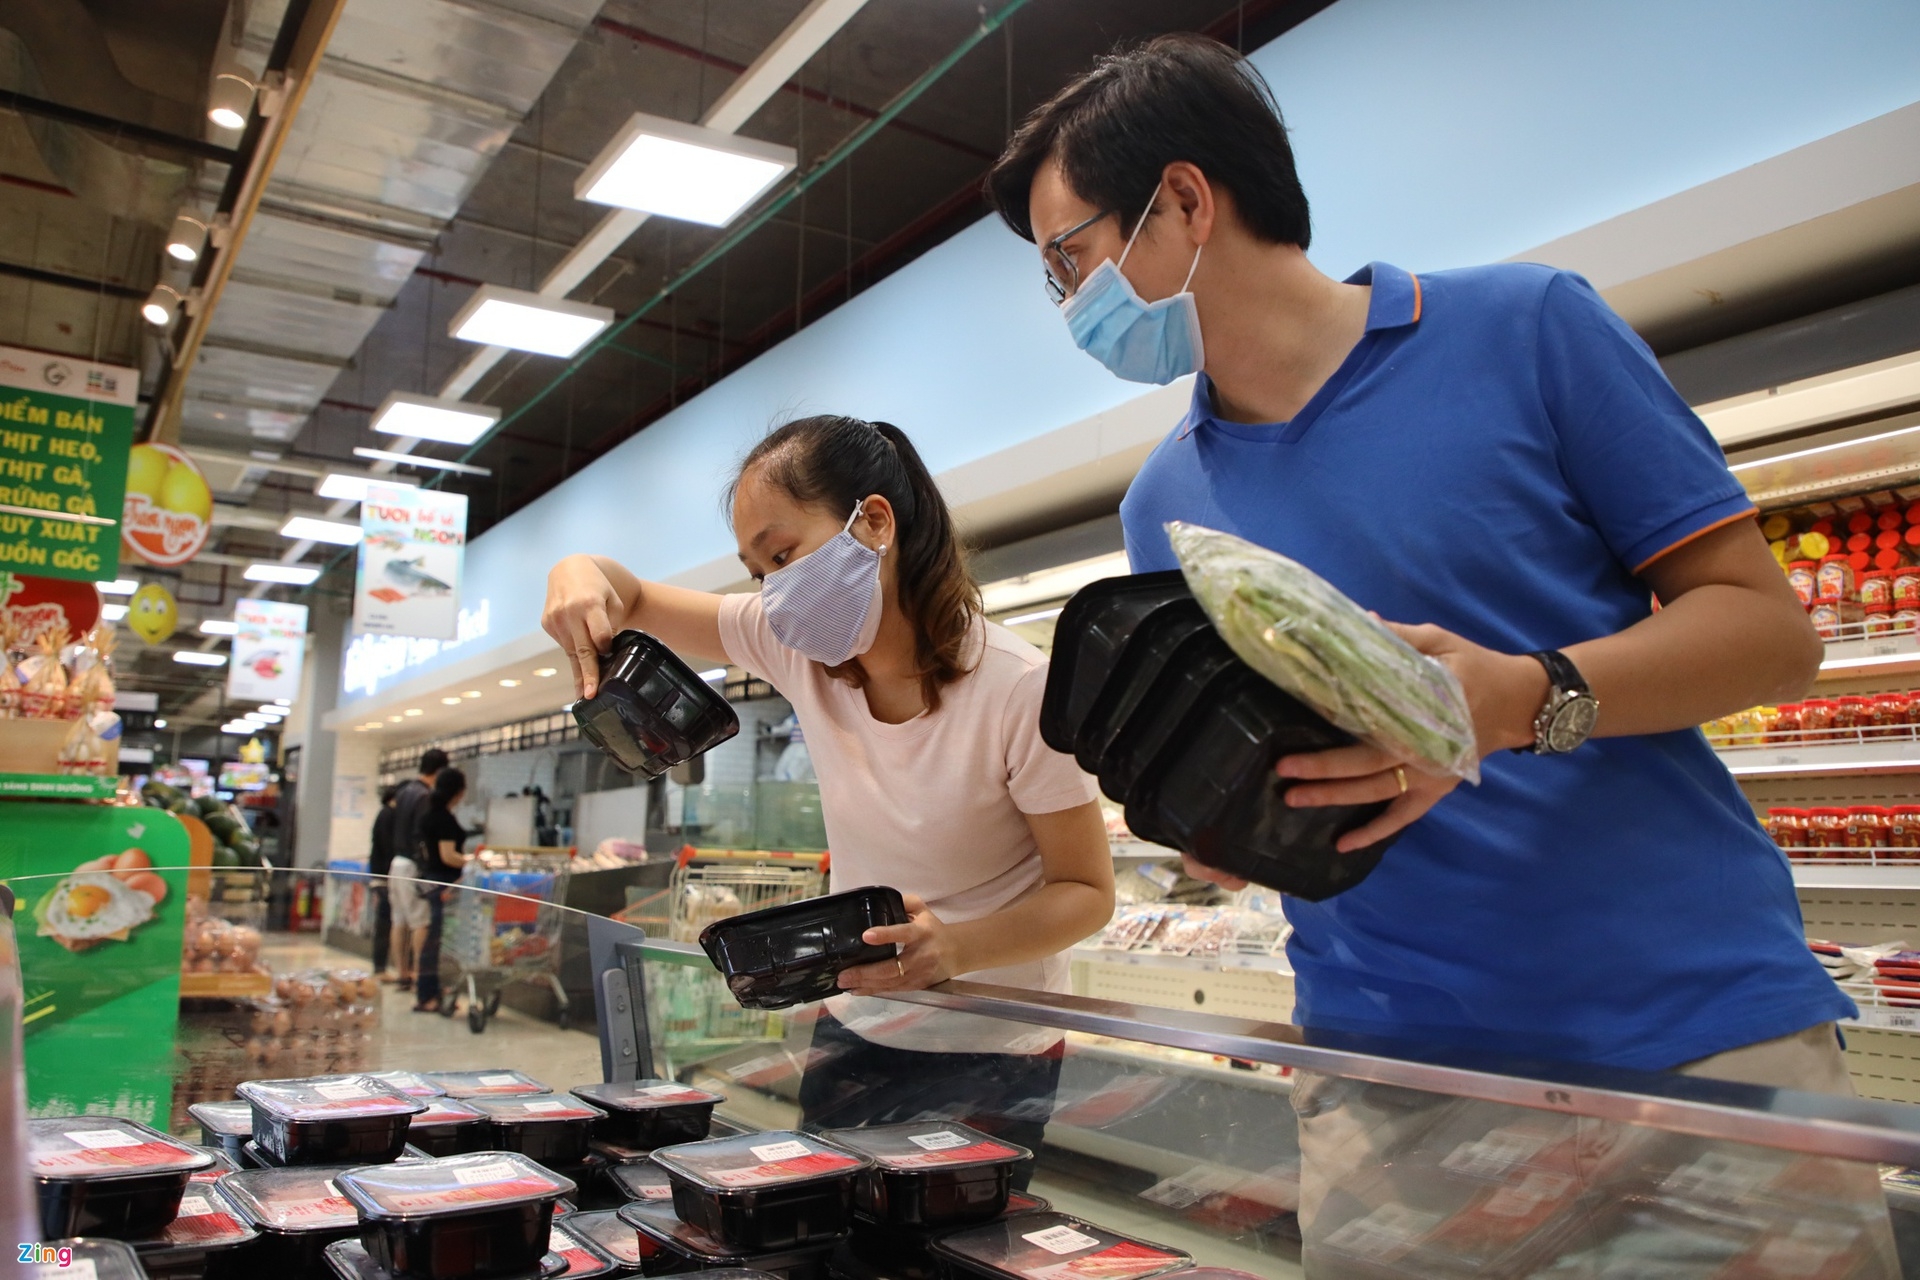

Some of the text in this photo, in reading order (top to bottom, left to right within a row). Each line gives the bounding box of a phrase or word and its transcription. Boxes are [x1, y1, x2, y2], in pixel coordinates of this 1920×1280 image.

[0, 396, 104, 434] IỂM BÁN
[0, 429, 102, 464] HỊT HEO,
[53, 464, 92, 490] GÀ,
[66, 494, 98, 515] GÀ
[0, 516, 34, 535] UY
[52, 546, 100, 572] GỐC
